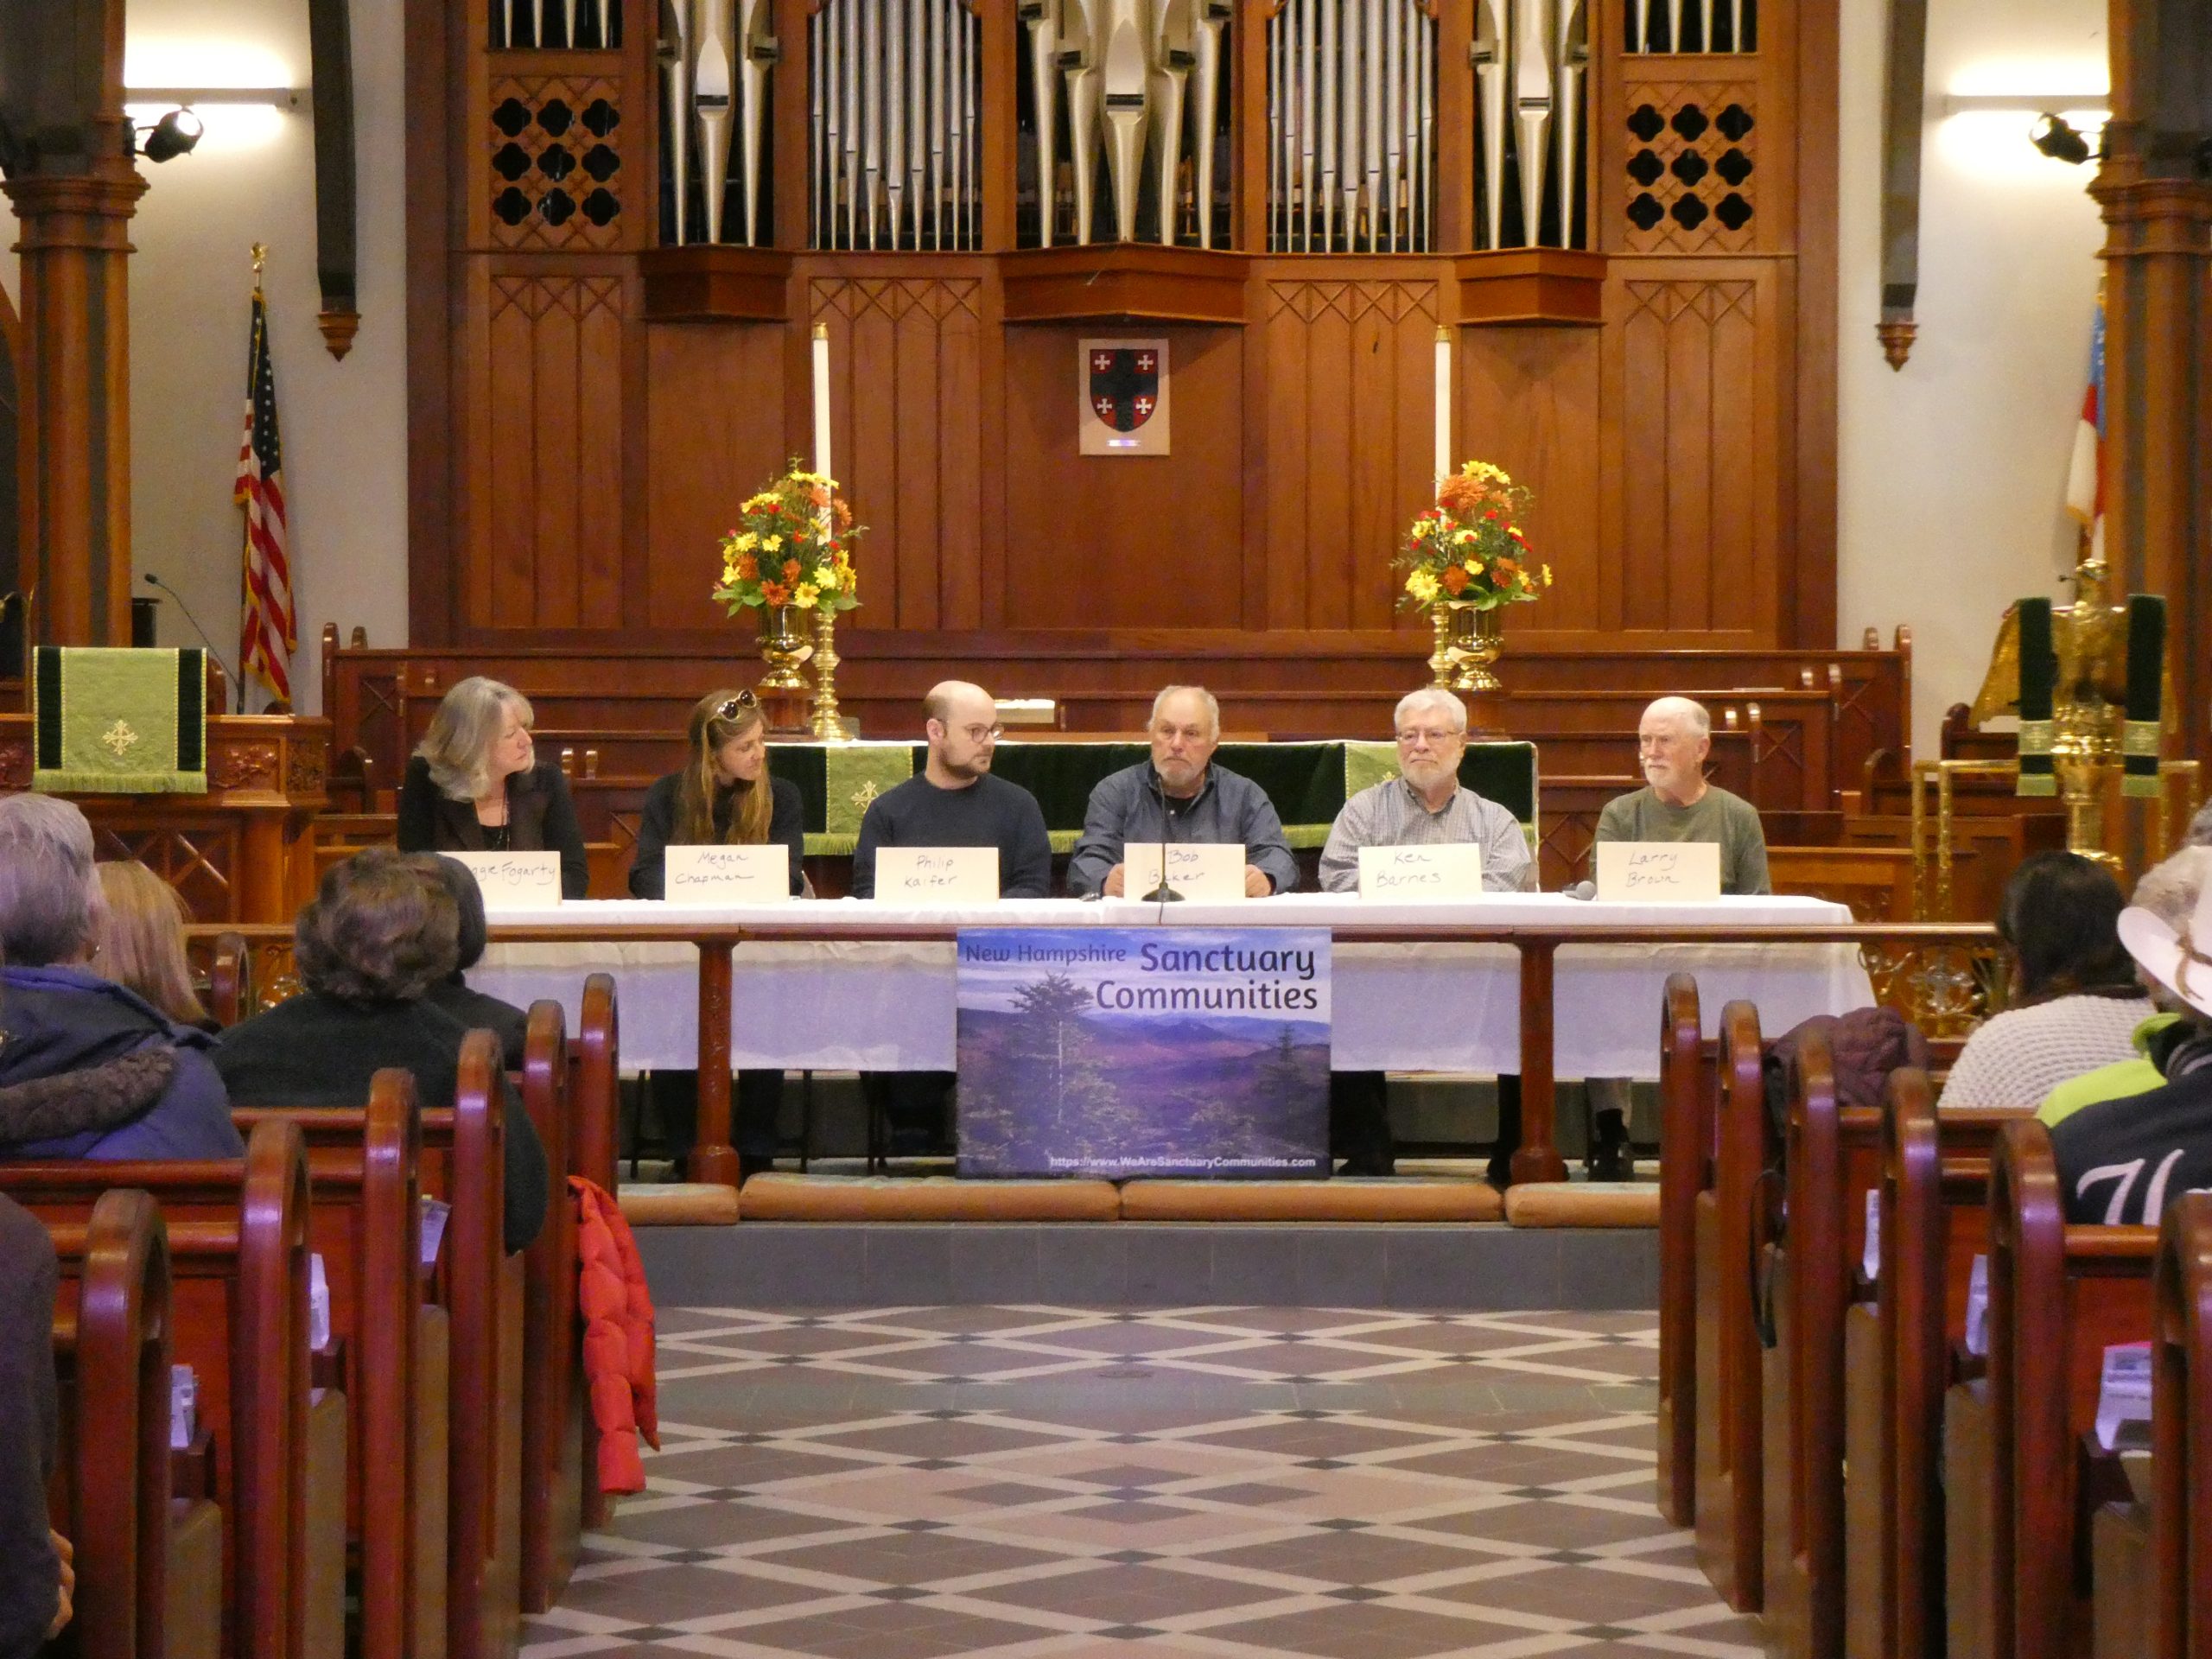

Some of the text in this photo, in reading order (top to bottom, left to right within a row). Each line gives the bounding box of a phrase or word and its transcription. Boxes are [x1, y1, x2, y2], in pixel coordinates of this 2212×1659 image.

[697, 851, 748, 870] Megan
[916, 855, 954, 871] Philip
[1167, 849, 1199, 865] Bob
[1393, 851, 1433, 865] Ken
[1628, 850, 1678, 871] Larry
[501, 861, 556, 886] Fogarty
[675, 873, 754, 885] Chapman
[1376, 870, 1441, 888] Barnes
[1625, 872, 1680, 888] Brown
[965, 943, 1315, 980] New Hampshire Sanctuary
[1096, 980, 1318, 1010] Communities
[1050, 1156, 1316, 1170] https://www.WeAreSanctuaryCommunities.com
